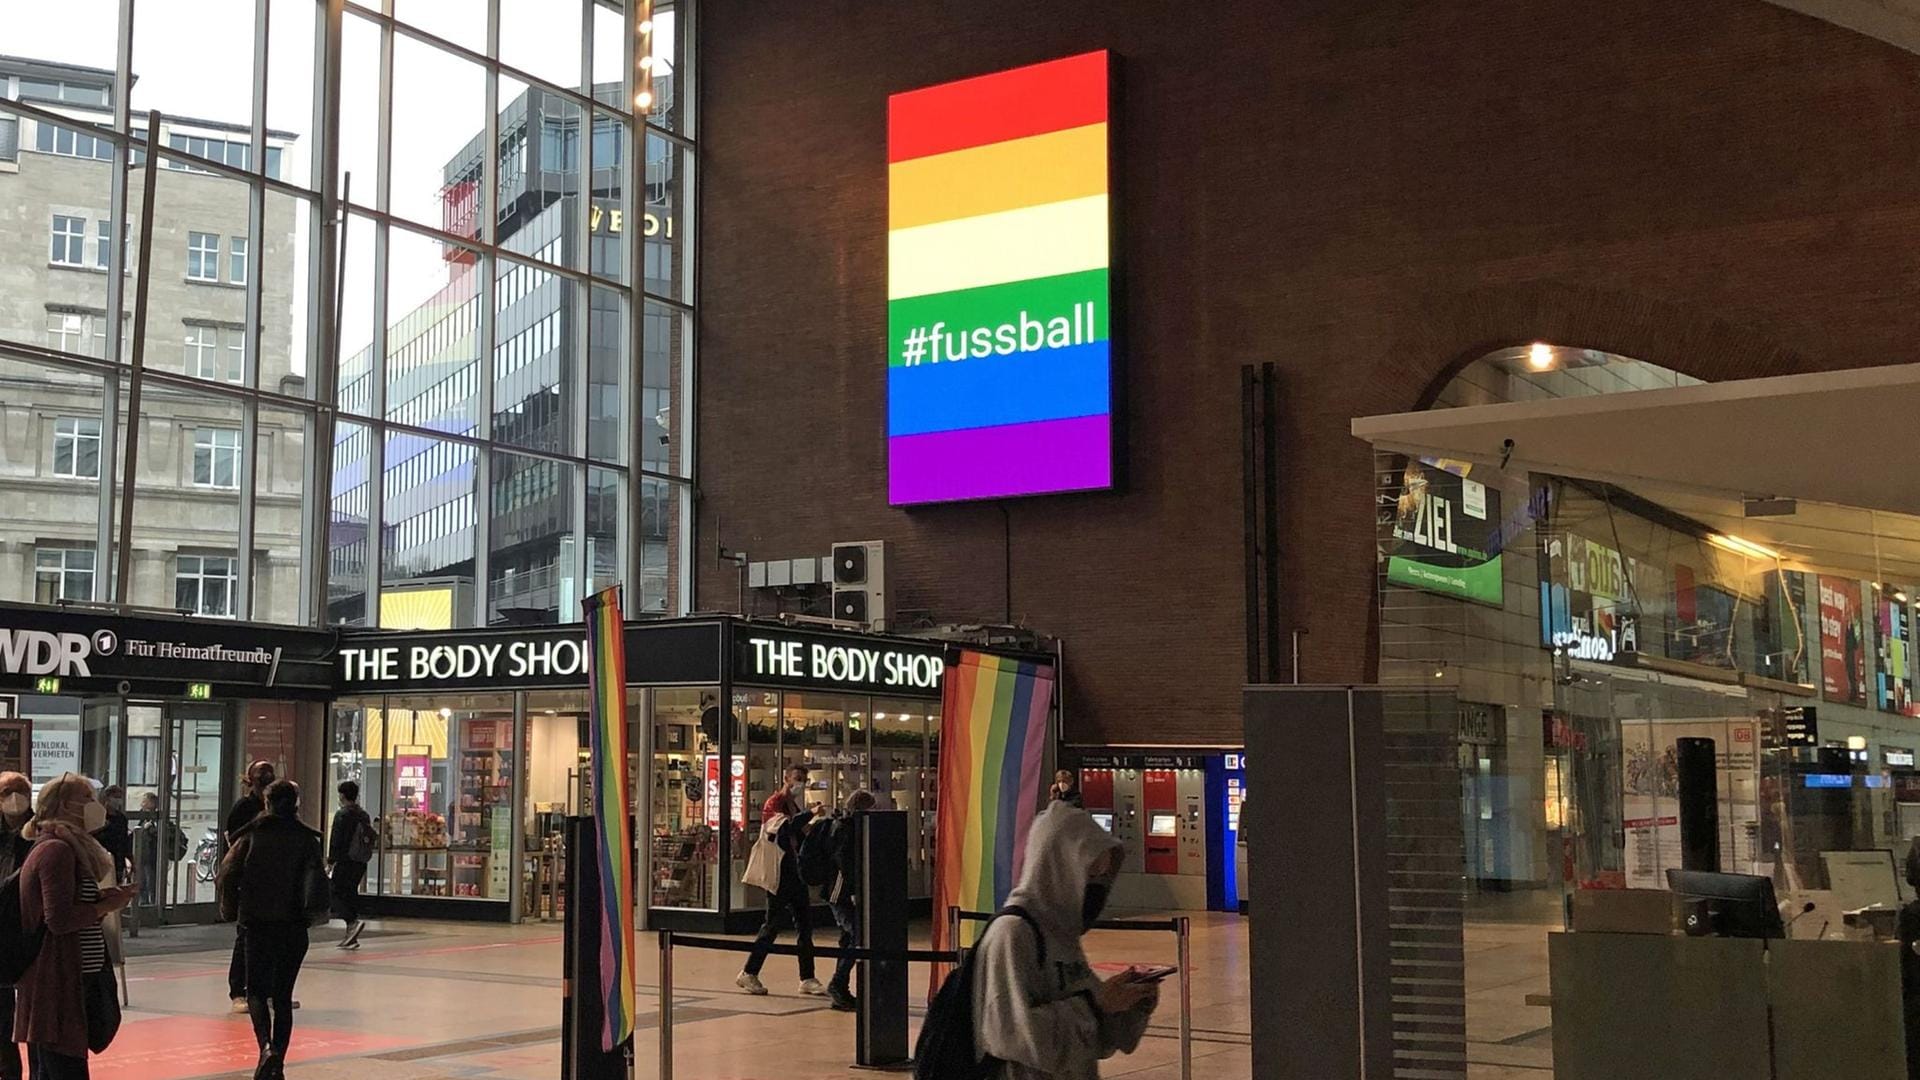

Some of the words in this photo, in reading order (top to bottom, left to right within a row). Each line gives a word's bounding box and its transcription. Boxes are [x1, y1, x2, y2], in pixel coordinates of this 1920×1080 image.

[902, 301, 1094, 367] #fussball
[1414, 493, 1457, 554] ZIEL
[0, 628, 92, 677] WDR
[126, 639, 156, 658] Für
[159, 641, 272, 666] Heimatfreunde
[340, 648, 399, 681] THE
[411, 643, 502, 680] BODY
[750, 638, 804, 677] THE
[812, 644, 879, 683] BODY
[884, 652, 943, 688] SHOP
[33, 750, 74, 758] VERMIETEN
[709, 779, 743, 796] SE
